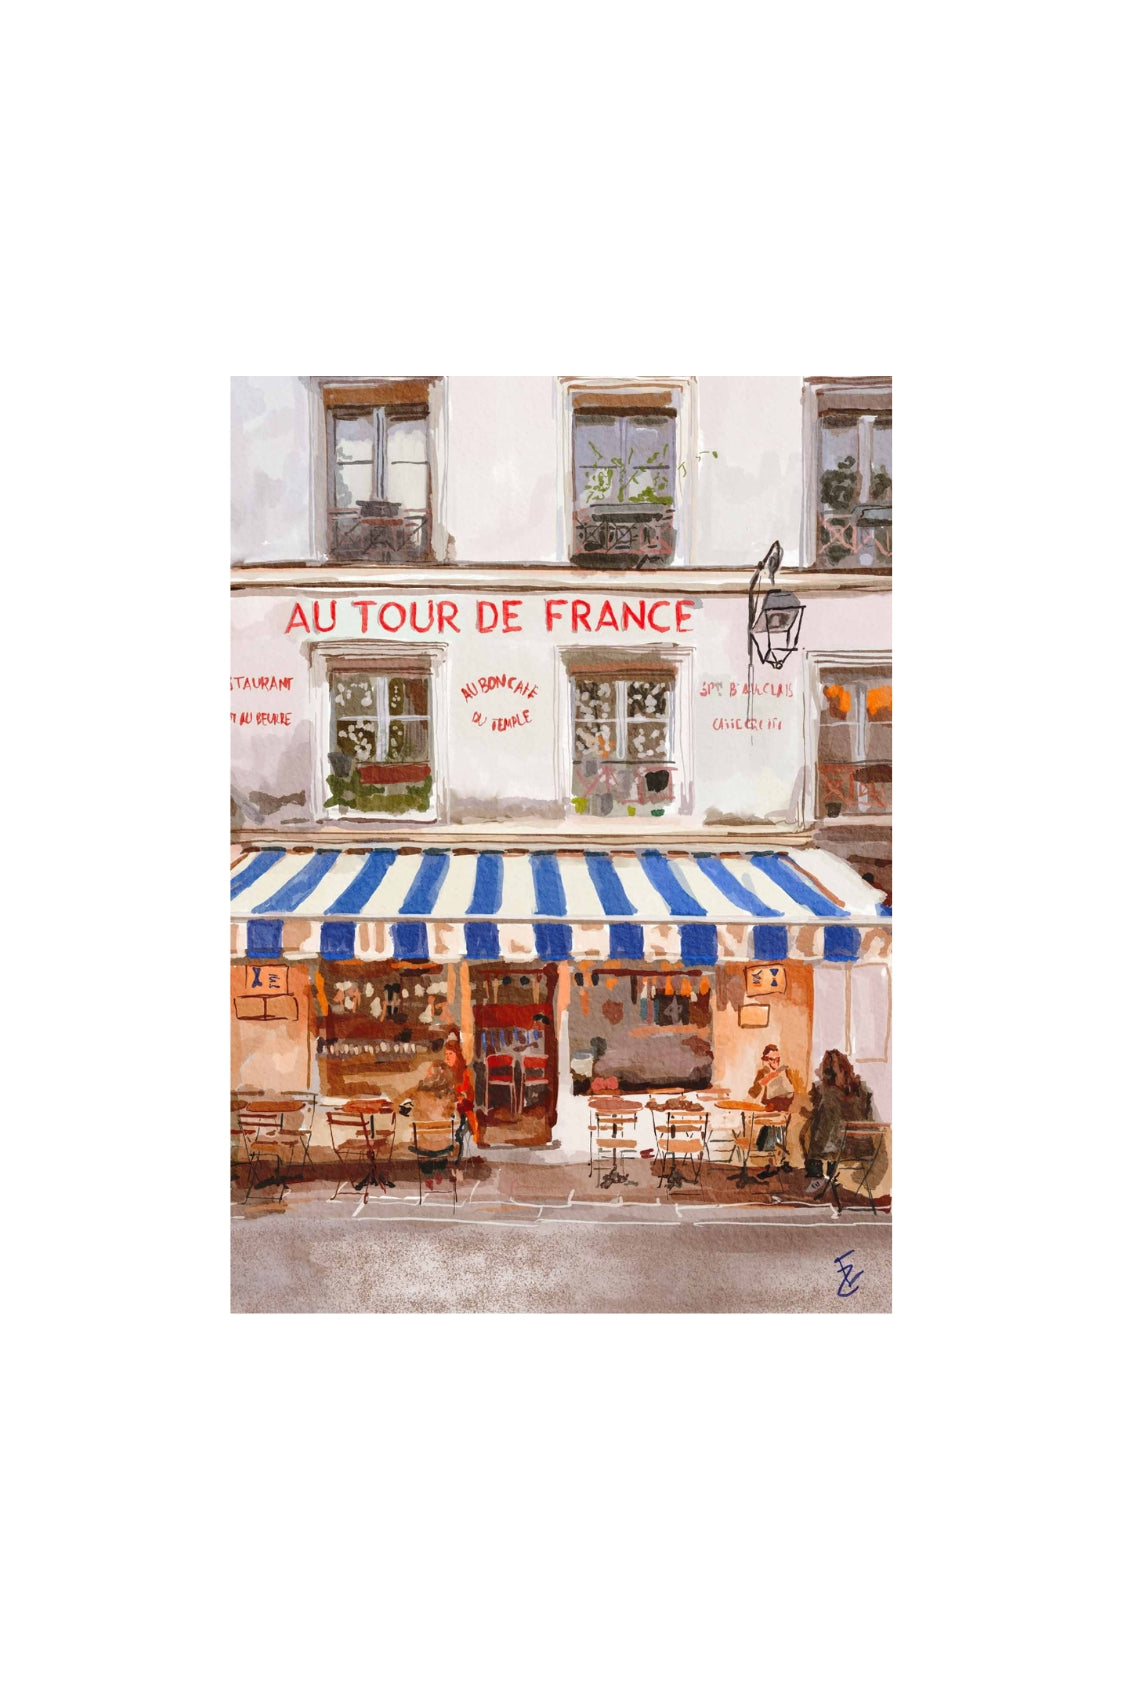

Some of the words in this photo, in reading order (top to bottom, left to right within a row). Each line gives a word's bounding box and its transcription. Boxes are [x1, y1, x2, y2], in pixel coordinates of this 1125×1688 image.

[286, 599, 338, 634] AU
[352, 599, 461, 634] TOUR
[476, 599, 523, 634] DE
[546, 599, 696, 633] FRANCE
[239, 712, 253, 726] AU
[256, 712, 292, 726] BEURRE
[472, 711, 487, 727] DU
[492, 709, 533, 732] TEMPLE
